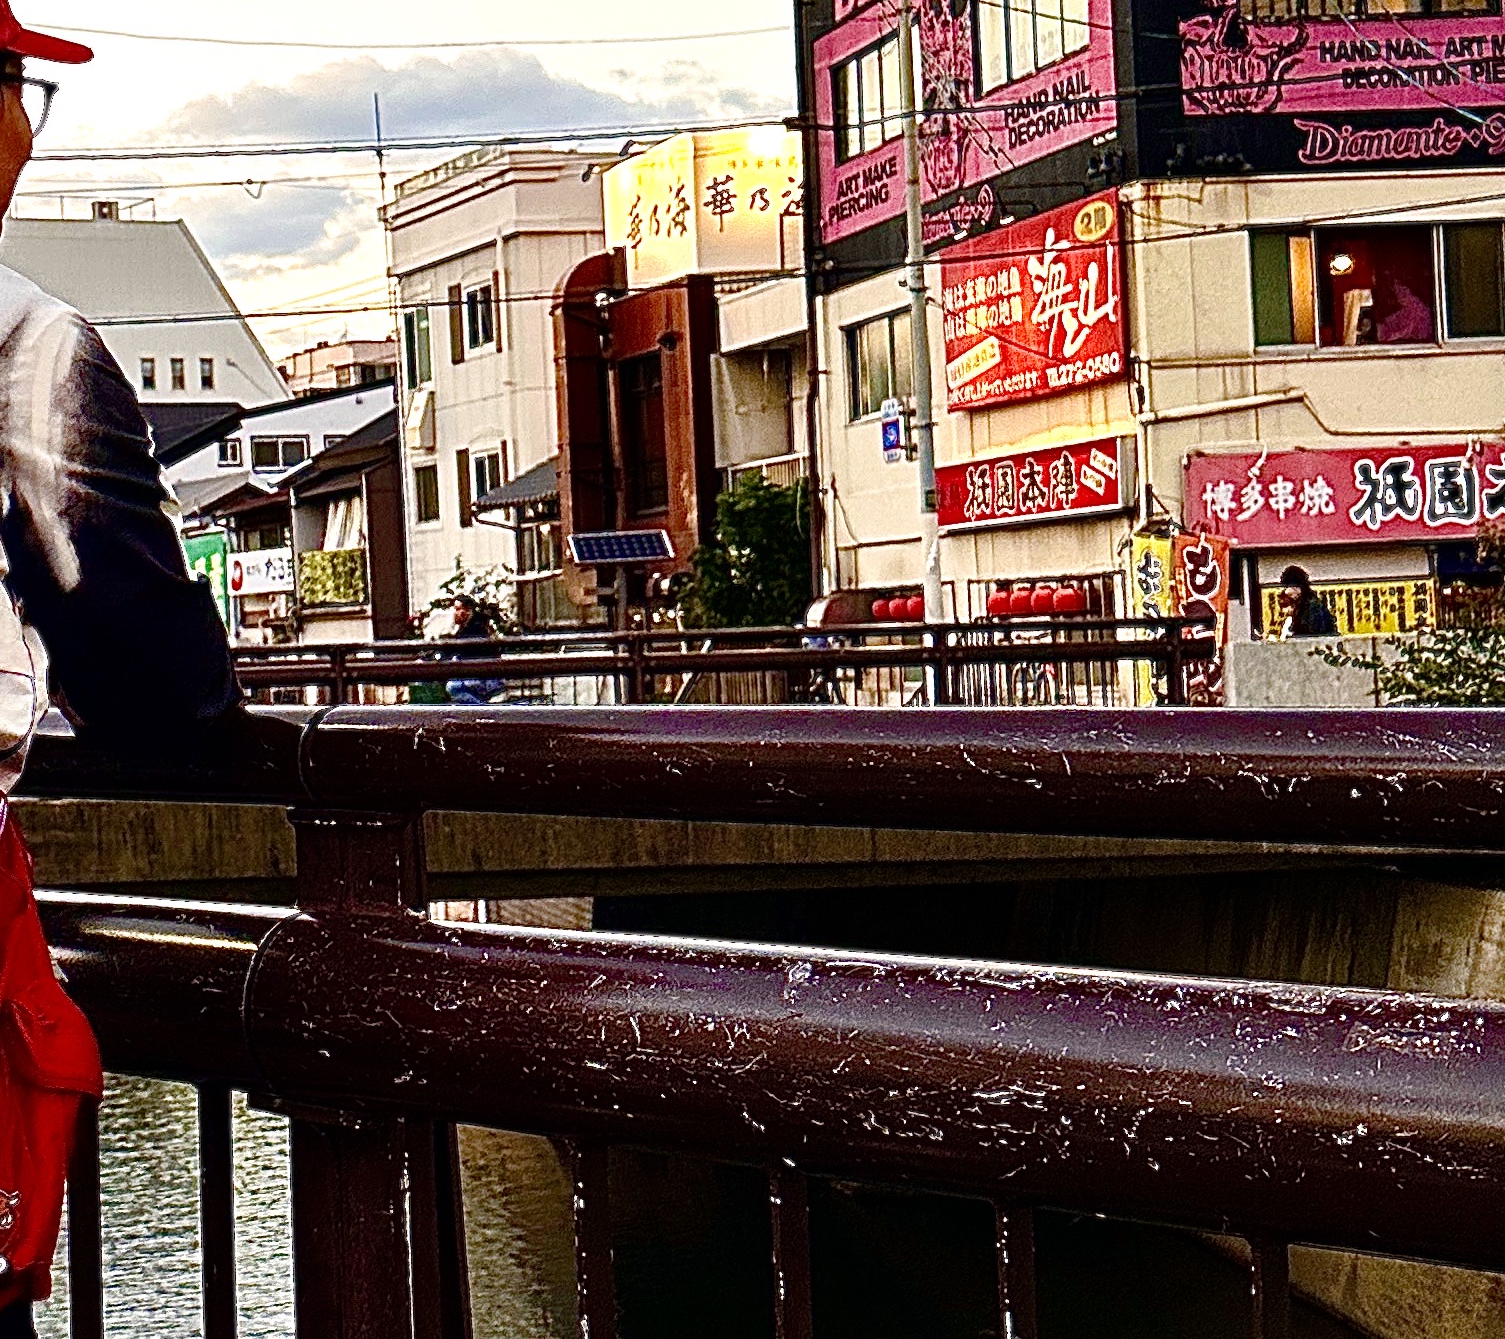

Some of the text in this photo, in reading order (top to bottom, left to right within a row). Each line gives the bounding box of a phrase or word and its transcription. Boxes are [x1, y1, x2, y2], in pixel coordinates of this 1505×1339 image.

[1320, 40, 1382, 62] HAND
[1445, 36, 1487, 58] ART
[1051, 69, 1092, 105] NAIL
[1008, 90, 1101, 149] DECORATION
[836, 156, 897, 201] ART MAKE
[828, 182, 889, 226] PIERCING
[1202, 474, 1337, 522] 博多串焼
